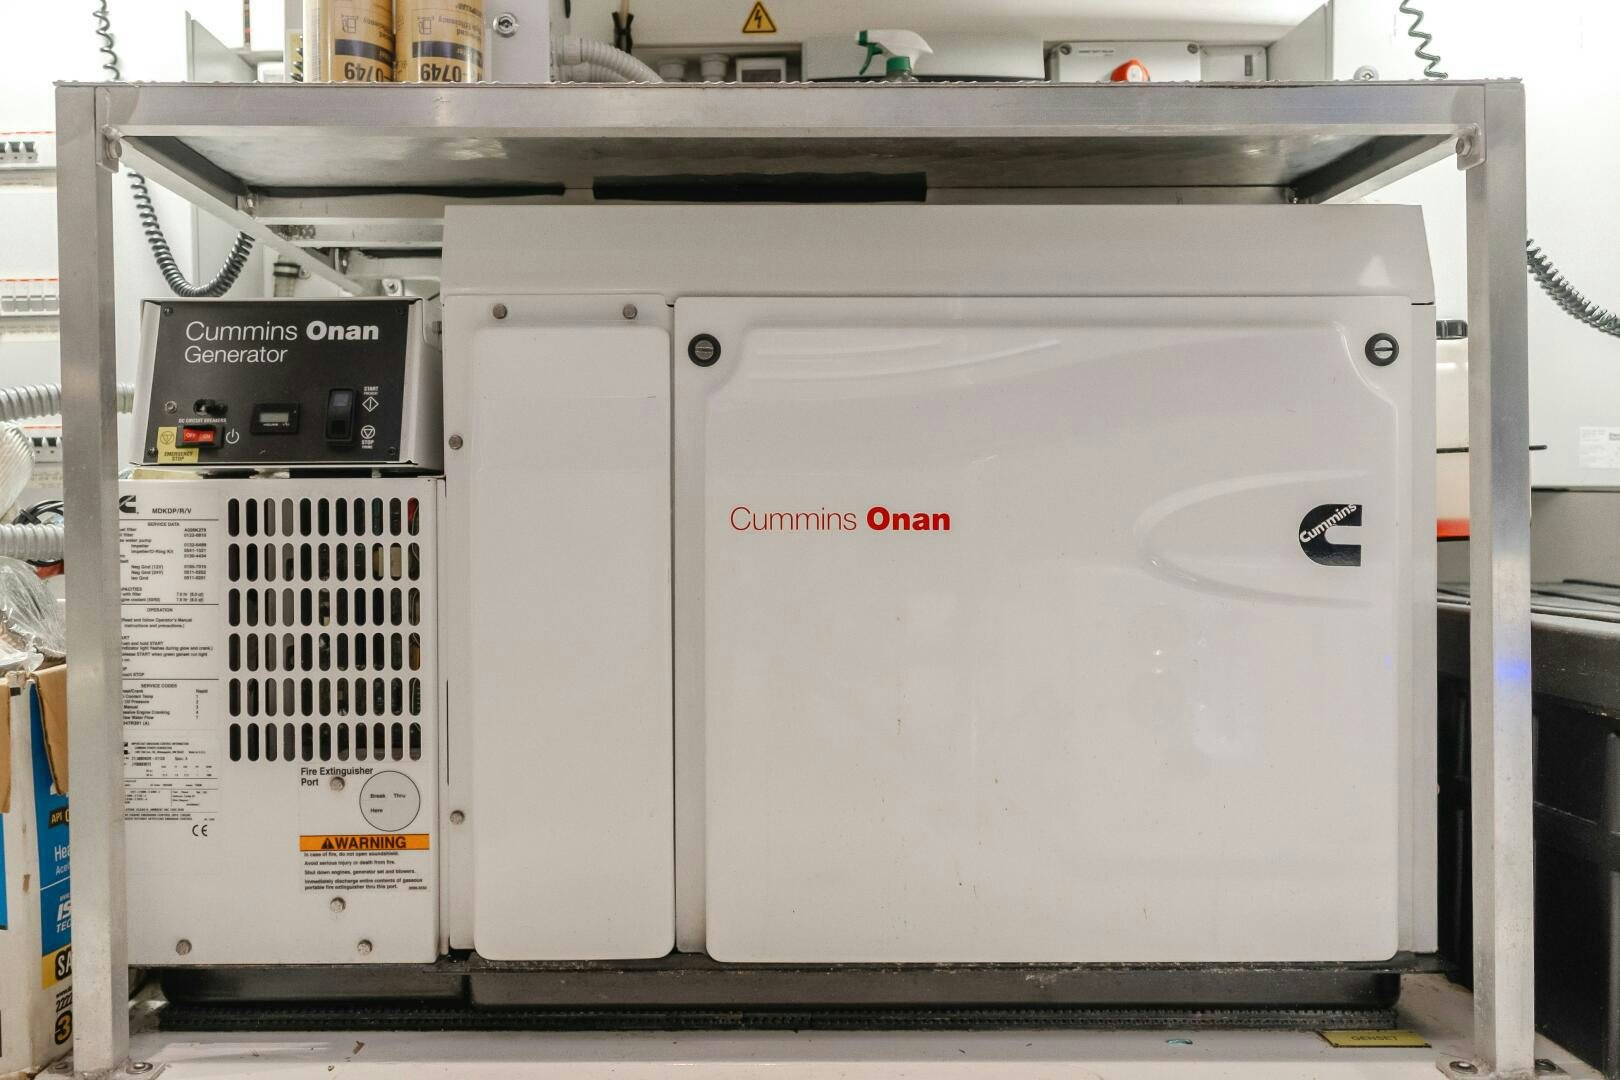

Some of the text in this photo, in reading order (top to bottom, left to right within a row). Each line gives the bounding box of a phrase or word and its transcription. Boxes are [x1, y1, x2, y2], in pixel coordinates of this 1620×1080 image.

[186, 321, 379, 341] Cummins Onan
[184, 346, 288, 363] Generator
[730, 507, 950, 530] Cummins Onan
[1300, 504, 1357, 542] Cummins
[320, 767, 373, 776] Extinguisher
[302, 778, 318, 786] Port
[51, 811, 62, 824] API
[335, 836, 406, 848] WARNING
[58, 952, 72, 976] SA
